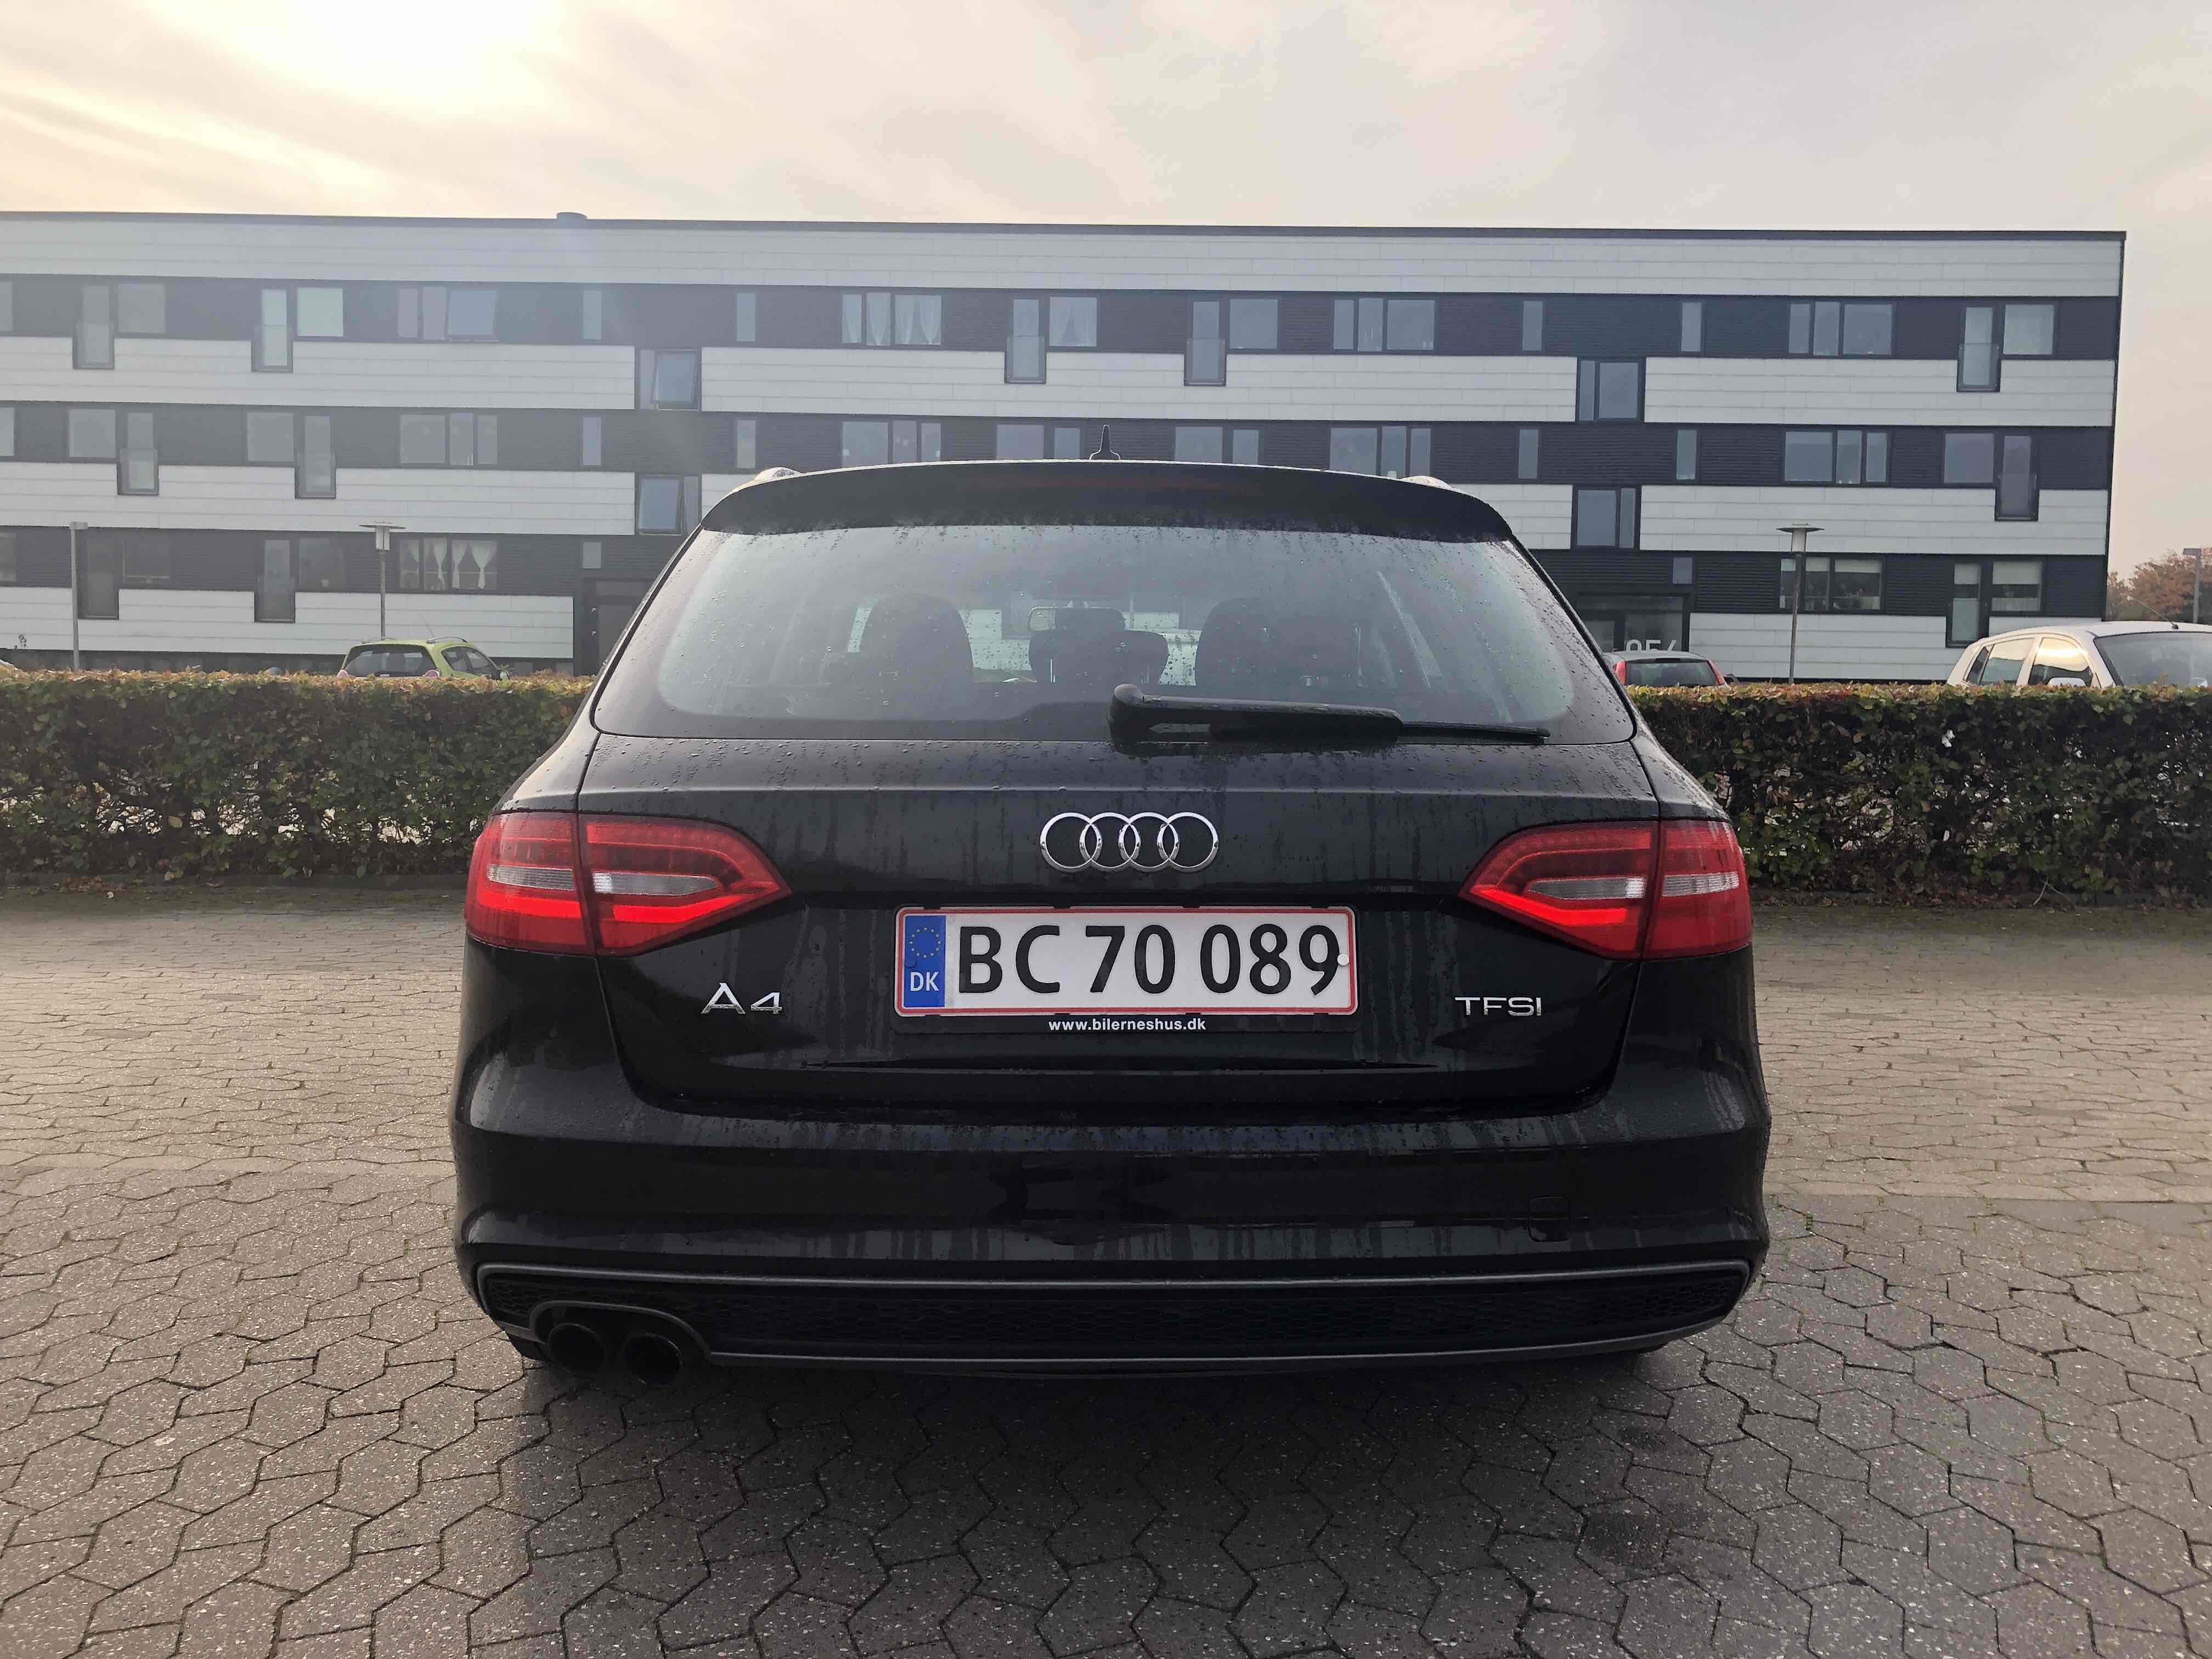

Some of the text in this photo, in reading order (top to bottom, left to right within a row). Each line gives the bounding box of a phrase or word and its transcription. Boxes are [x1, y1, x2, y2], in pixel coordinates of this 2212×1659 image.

[959, 923, 1340, 996] BC 70 089
[910, 972, 940, 991] DK
[701, 982, 782, 1014] A4
[1454, 997, 1542, 1016] TFSI
[1048, 1018, 1206, 1031] www.bilerneshus.dk
